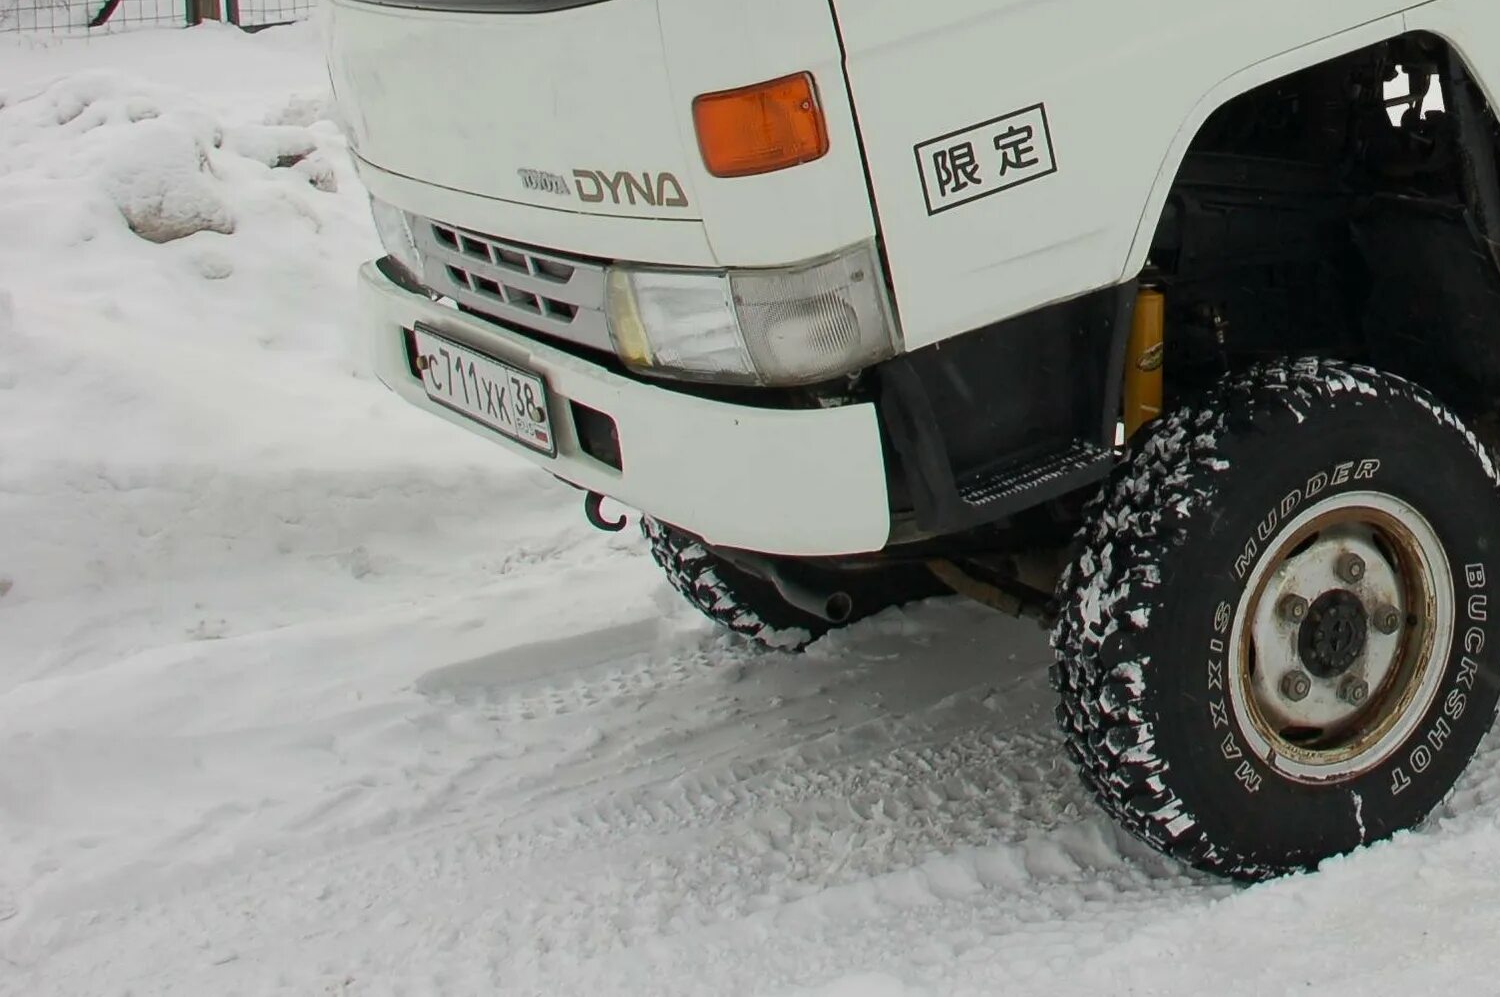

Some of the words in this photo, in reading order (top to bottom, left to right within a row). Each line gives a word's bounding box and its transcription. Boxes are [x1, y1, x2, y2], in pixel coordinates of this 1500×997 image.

[572, 168, 689, 208] DYNA
[932, 125, 1039, 198] 限定
[1233, 457, 1382, 580] MUDDER
[1208, 600, 1262, 793] MAXXIS
[1391, 561, 1488, 796] BUCKSHOT
